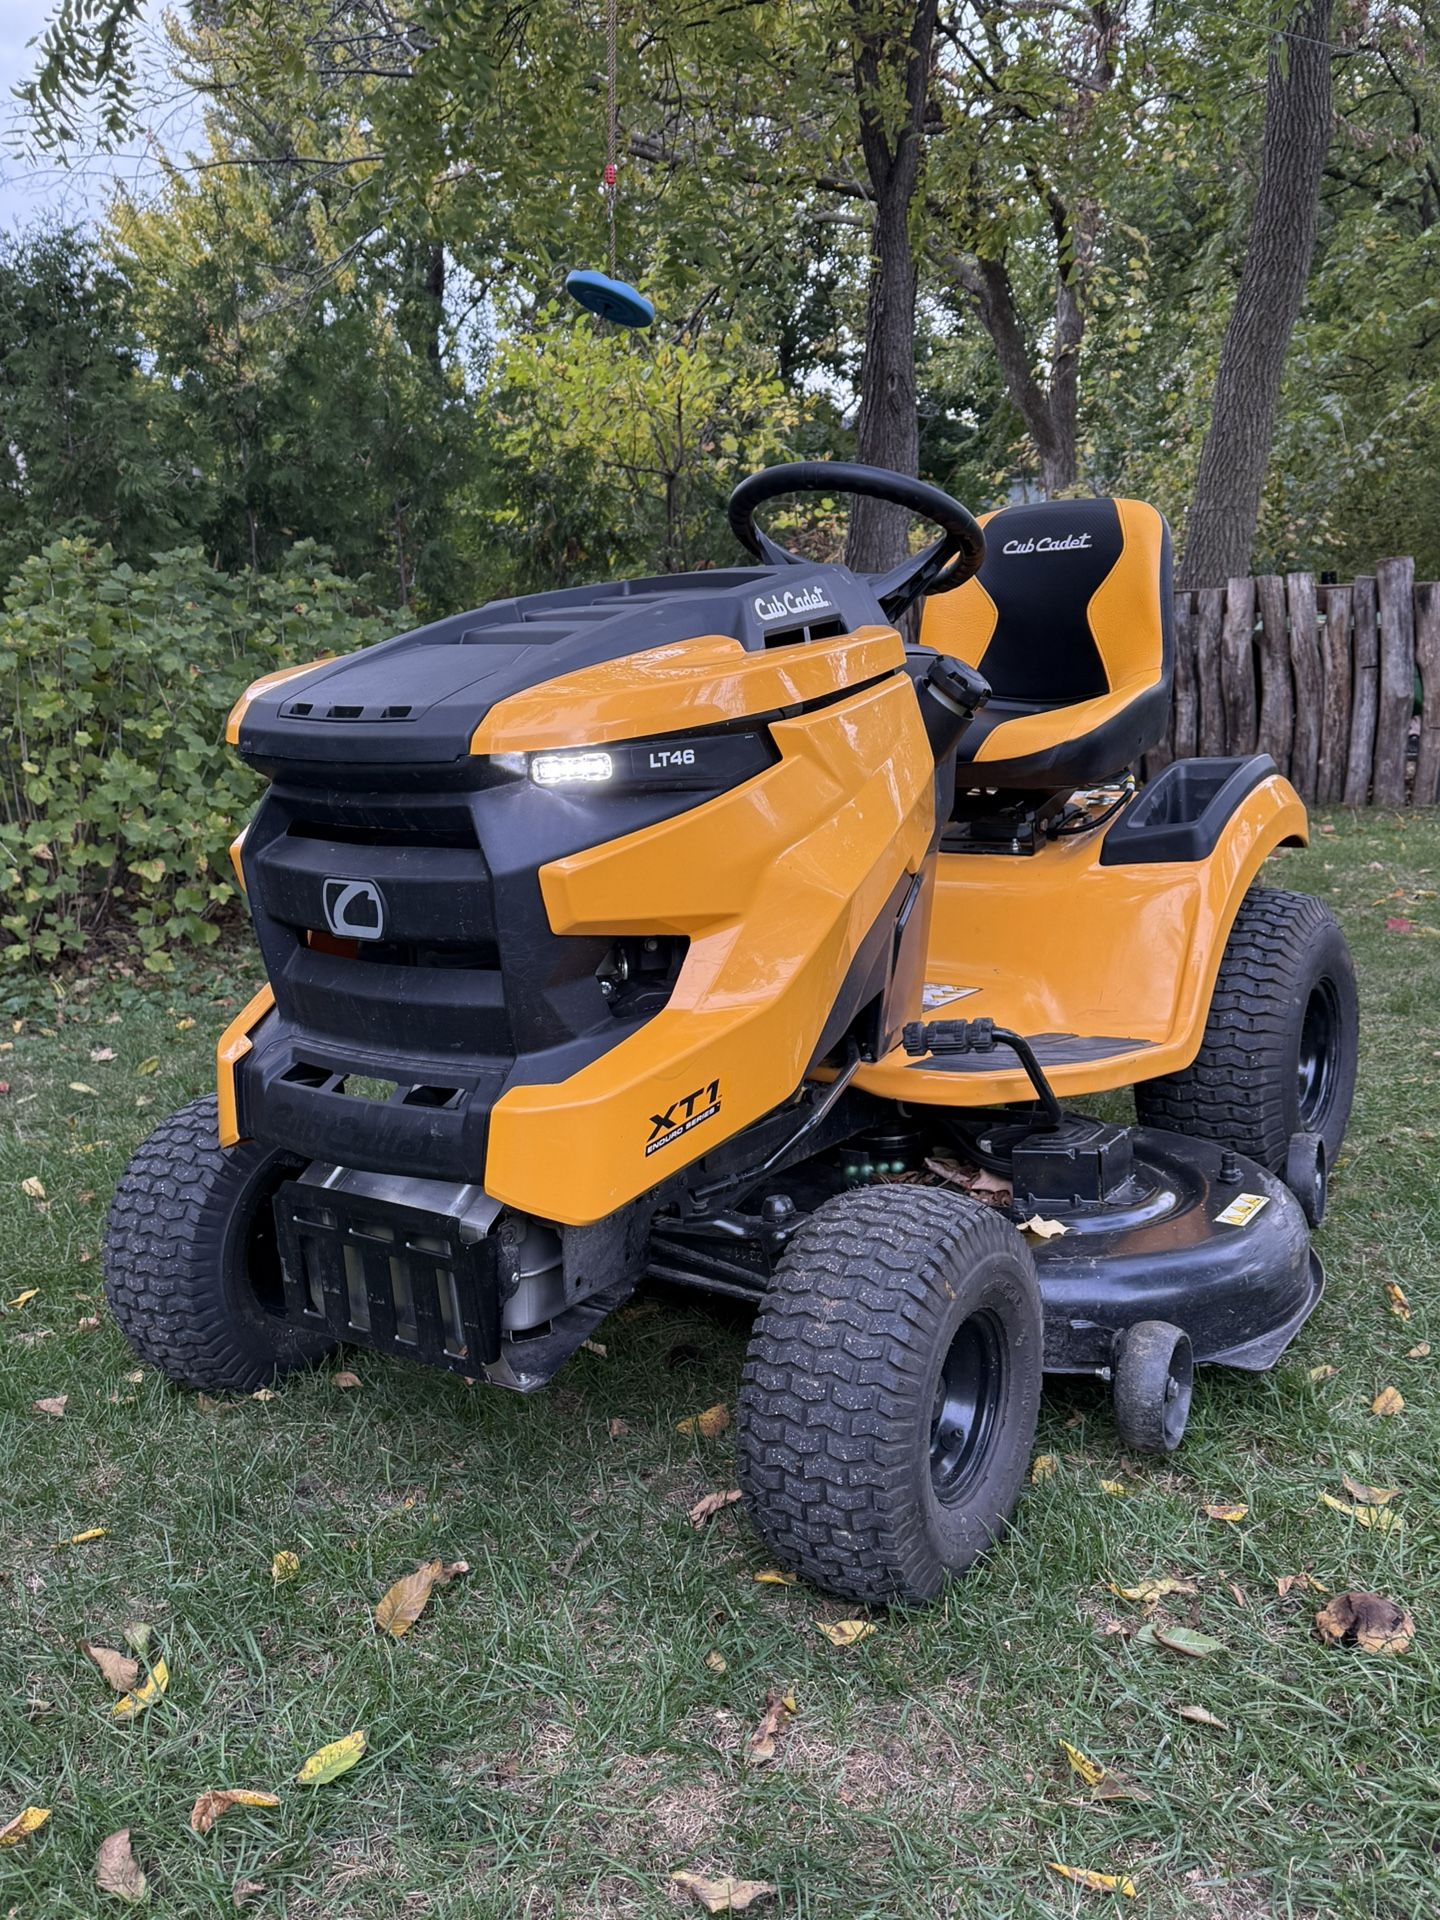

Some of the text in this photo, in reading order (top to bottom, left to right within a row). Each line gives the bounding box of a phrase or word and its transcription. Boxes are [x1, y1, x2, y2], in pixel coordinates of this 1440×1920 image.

[1003, 533, 1092, 554] Cub Cadet
[755, 586, 829, 620] Cub Cadet
[649, 749, 695, 768] LT46
[647, 1078, 720, 1143] XT1
[647, 1107, 715, 1154] ENDURO SERIES
